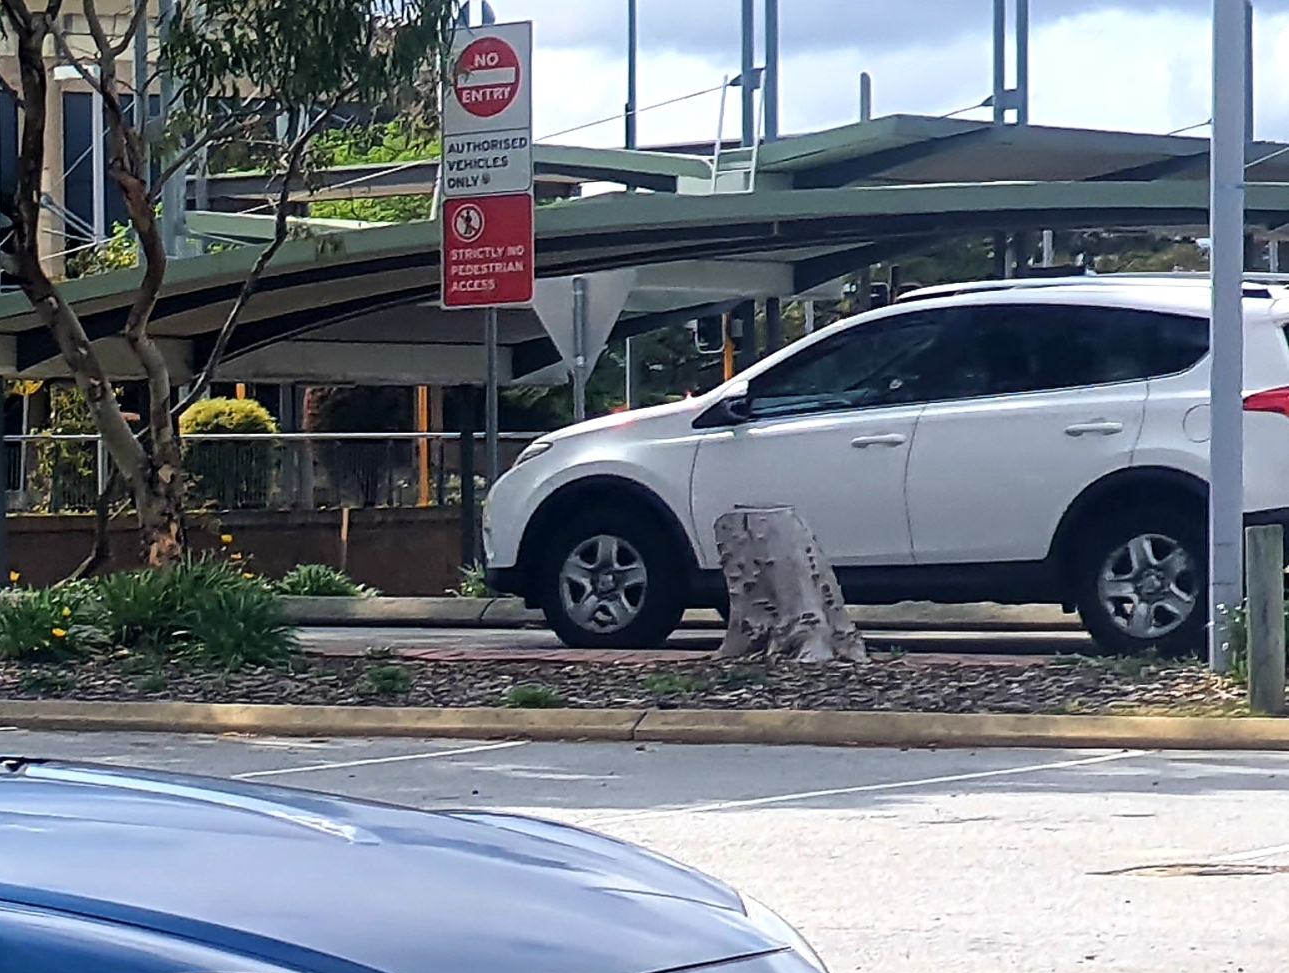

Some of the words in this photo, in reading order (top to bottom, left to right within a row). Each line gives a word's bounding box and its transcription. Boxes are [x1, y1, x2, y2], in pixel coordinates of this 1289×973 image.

[474, 52, 499, 67] NO
[461, 87, 511, 103] ENTRY
[447, 137, 527, 154] AUTHORISED
[446, 156, 508, 171] VEHICLES
[447, 175, 479, 188] ONLY
[451, 246, 504, 260] STRICTLY
[507, 245, 524, 257] NO
[451, 261, 524, 276] PEDESTRIAN
[451, 279, 496, 292] ACCESS
